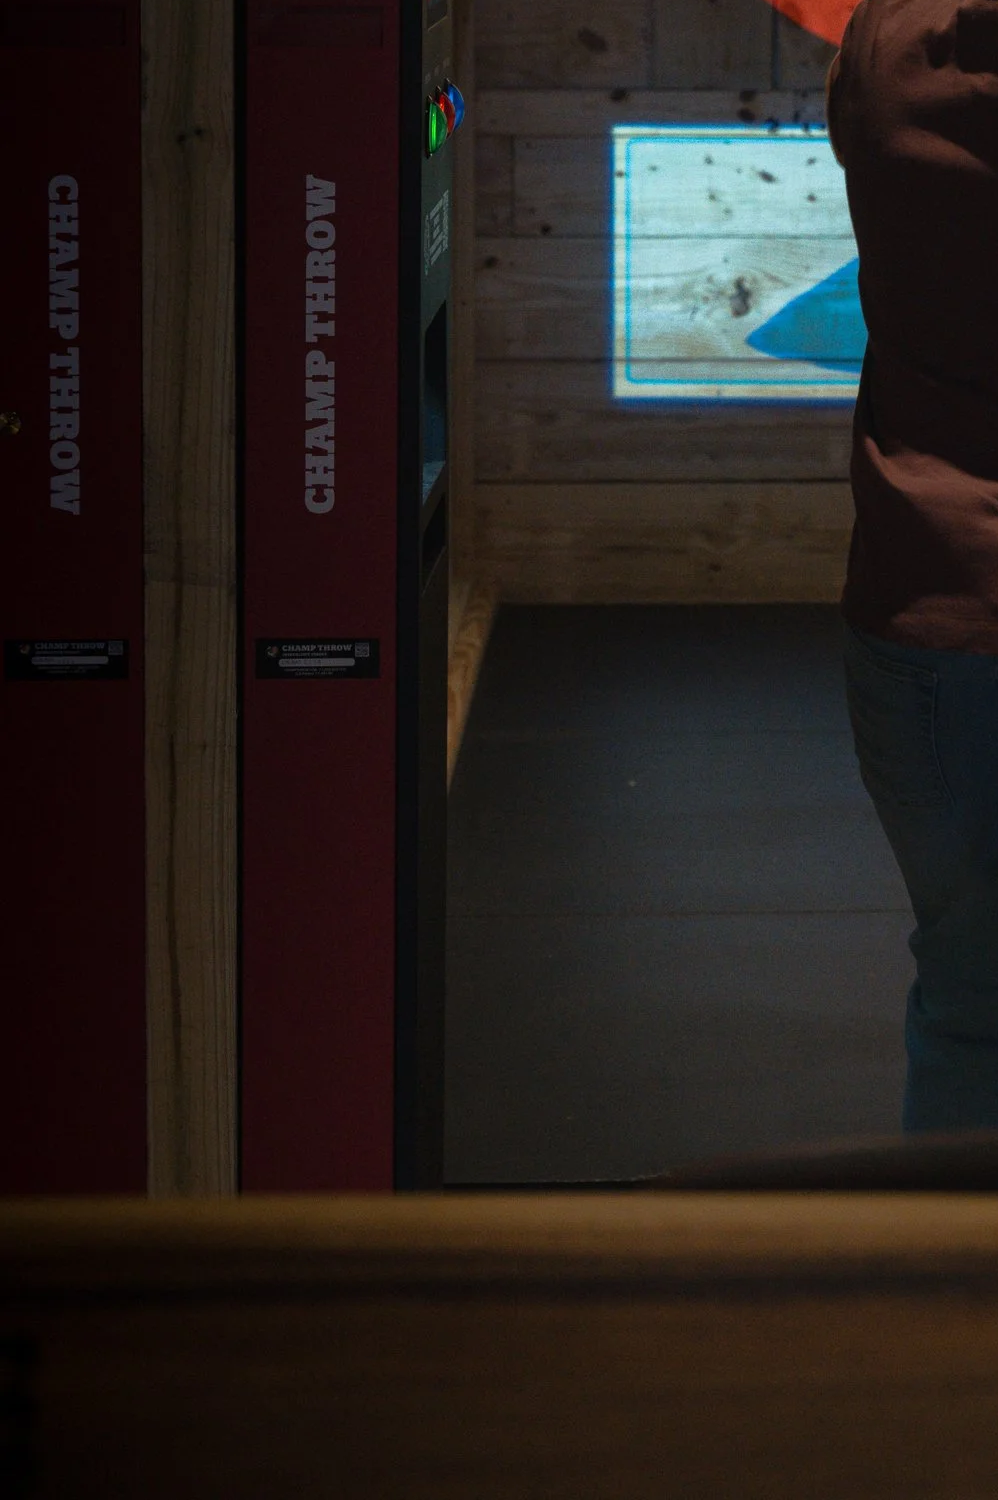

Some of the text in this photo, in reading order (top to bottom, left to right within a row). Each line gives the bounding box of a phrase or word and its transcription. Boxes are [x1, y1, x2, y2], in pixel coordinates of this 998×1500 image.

[47, 174, 81, 515] CHAMP THROW
[305, 173, 337, 515] CHAMP THROW
[34, 642, 105, 650] CHAMP THROW
[281, 643, 353, 652] CHAMP THROW
